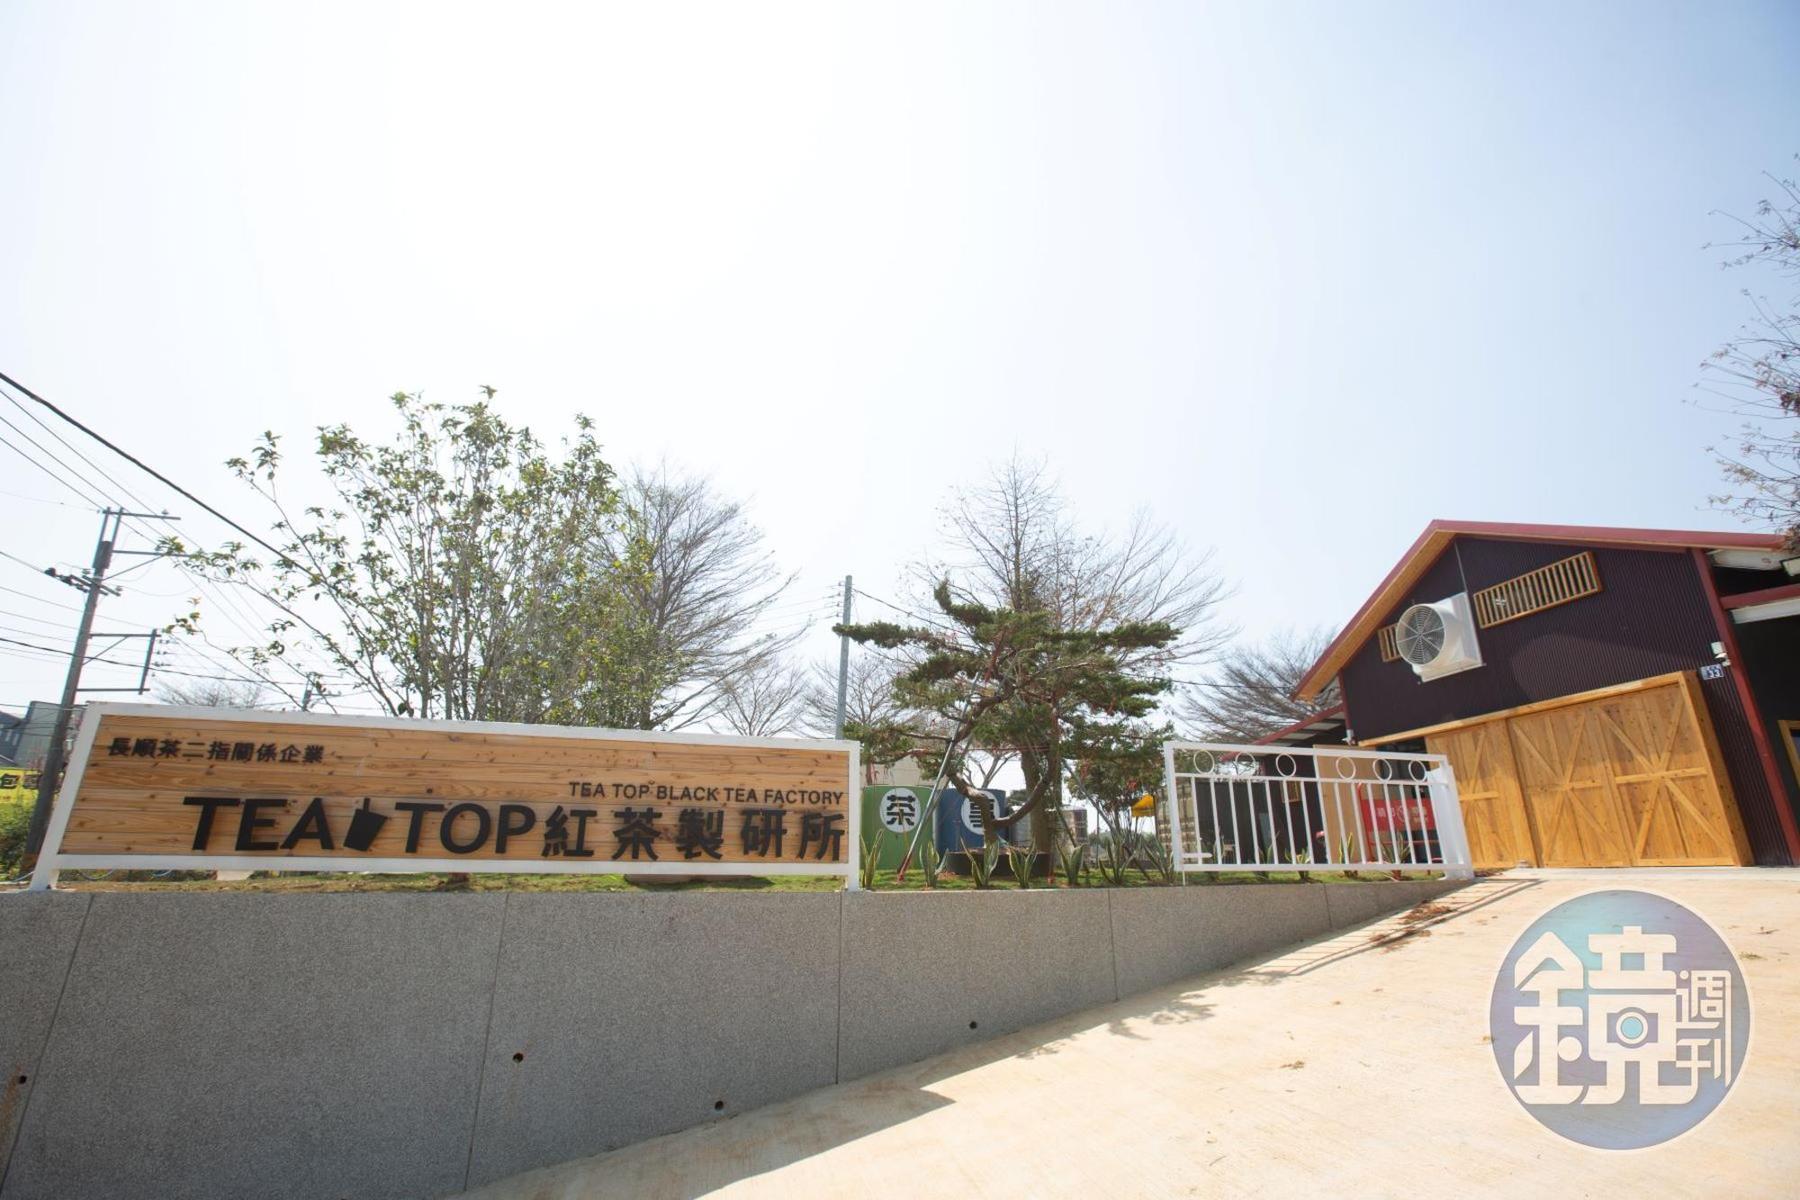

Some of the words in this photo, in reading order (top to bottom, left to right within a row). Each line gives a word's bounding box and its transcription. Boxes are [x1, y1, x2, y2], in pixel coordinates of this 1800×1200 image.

[569, 782, 605, 797] TEA
[612, 784, 650, 799] TOP
[657, 785, 719, 802] BLACK
[723, 788, 757, 803] TEA
[764, 789, 844, 805] FACTORY
[886, 794, 915, 825] 茶
[183, 796, 335, 852] TEA
[395, 801, 537, 855] TOP
[541, 804, 845, 862] 紅茶製研所
